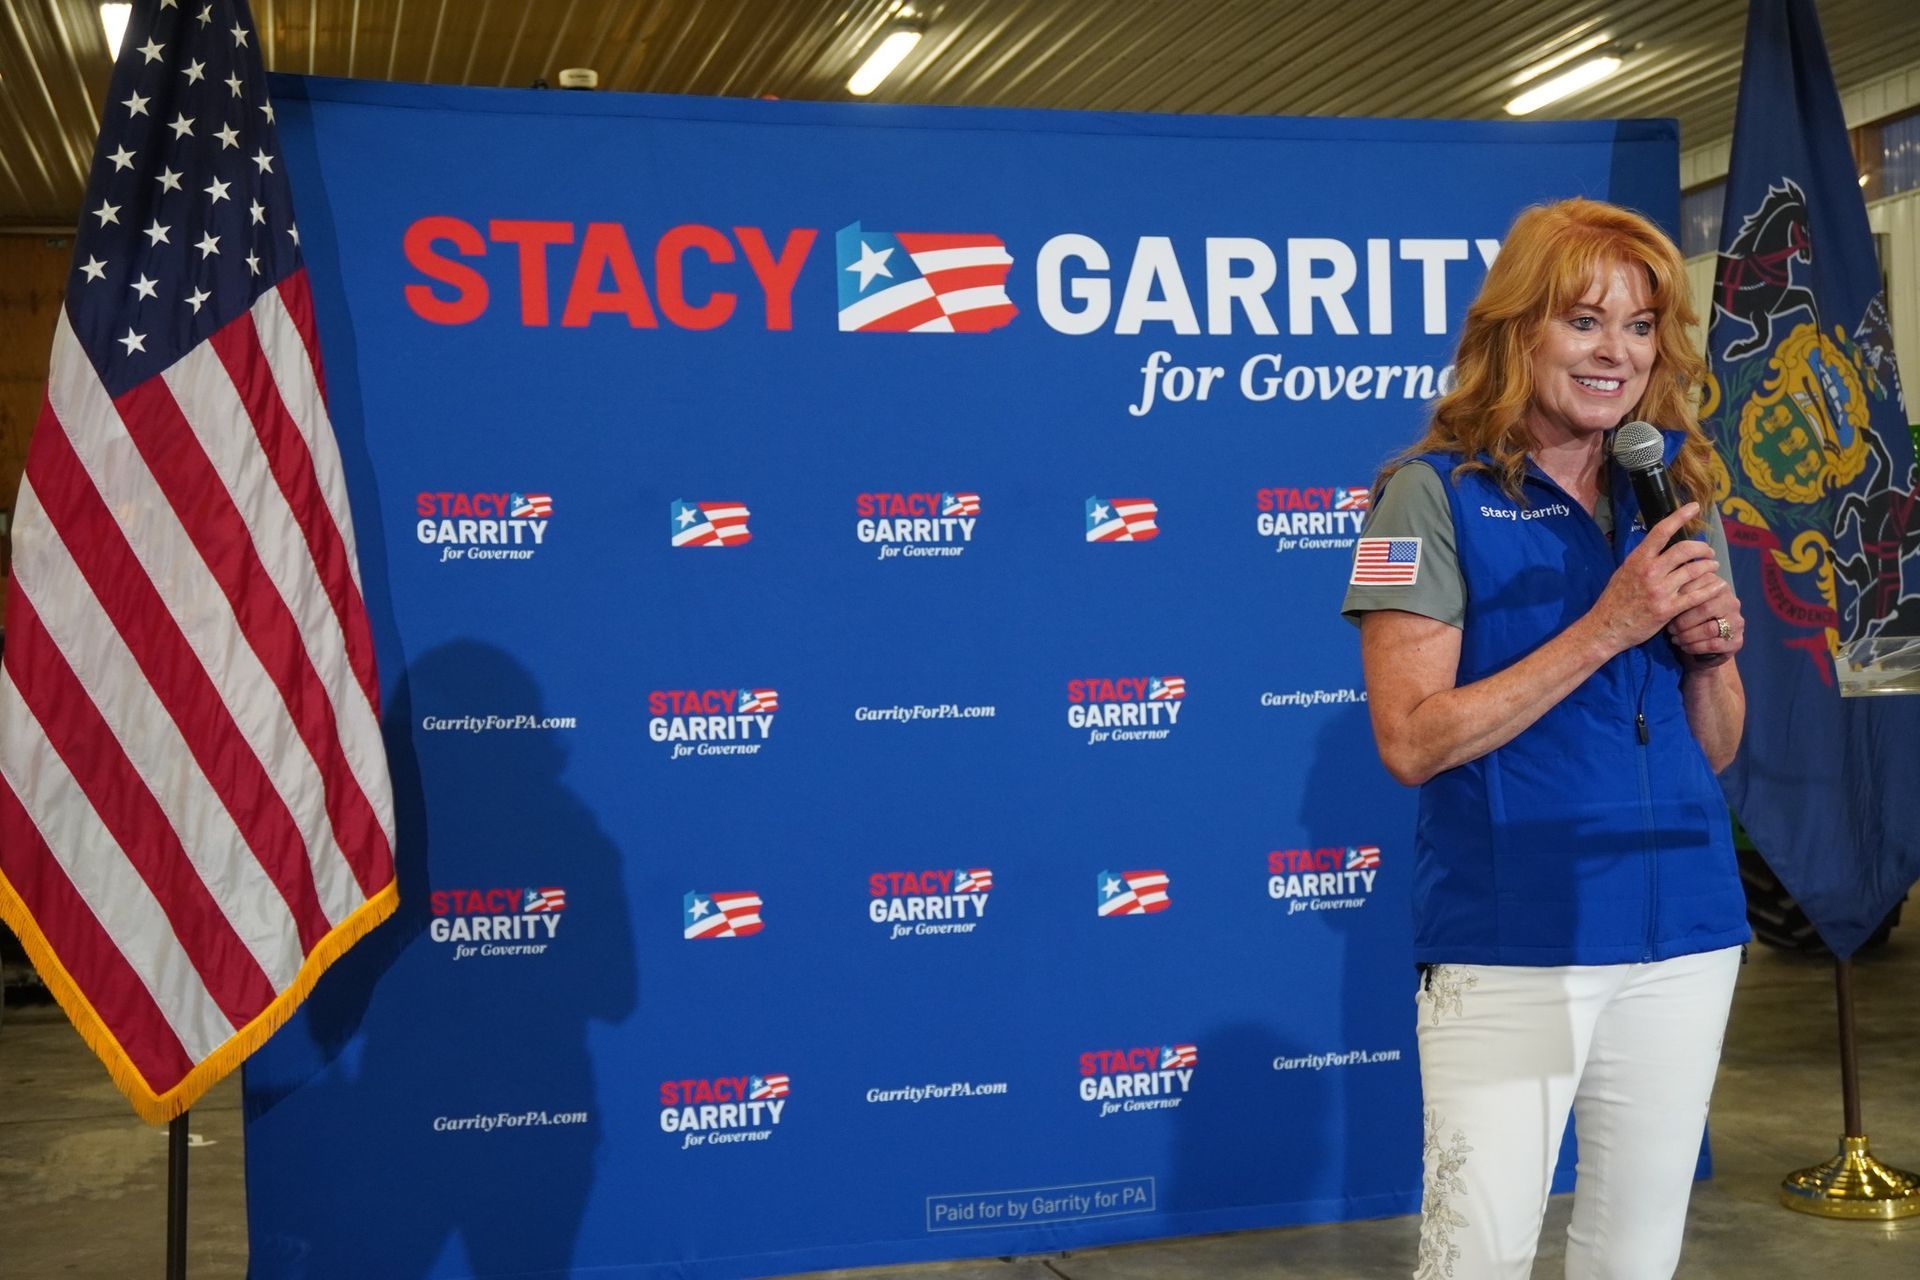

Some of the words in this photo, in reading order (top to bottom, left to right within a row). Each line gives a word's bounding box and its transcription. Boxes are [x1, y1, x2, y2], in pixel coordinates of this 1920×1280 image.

[403, 216, 818, 330] STACY
[1129, 351, 1224, 416] for
[1240, 354, 1456, 400] Govern
[417, 492, 508, 517] STACY
[857, 493, 942, 517] STACY
[1257, 488, 1334, 511] STACY
[1257, 511, 1365, 536] GARRITY
[1480, 506, 1517, 521] Stacy
[1521, 504, 1570, 521] Garrity
[417, 519, 547, 544] GARRITY
[857, 518, 976, 542] GARRITY
[440, 547, 463, 562] for
[468, 547, 534, 559] Governor
[878, 545, 899, 560] for
[903, 545, 963, 557] Governor
[1277, 537, 1297, 552] for
[1299, 537, 1355, 549] Governor
[1068, 677, 1148, 702] STACY
[1261, 689, 1368, 708] GarrityForPA.c
[649, 690, 737, 715] STACY
[855, 704, 996, 723] GarrityForPA.com
[1068, 701, 1182, 728] GARRITY
[423, 715, 576, 733] GarrityForPA.com
[649, 715, 774, 742] GARRITY
[1088, 730, 1109, 745] for
[1112, 729, 1169, 741] Governor
[671, 744, 694, 759] for
[697, 744, 760, 756] Governor
[1268, 848, 1344, 874] STACY
[870, 870, 953, 897] STACY
[1268, 870, 1376, 898] GARRITY
[431, 889, 522, 915] STACY
[870, 894, 988, 922] GARRITY
[1288, 900, 1308, 915] for
[1310, 898, 1365, 911] Governor
[431, 914, 561, 942] GARRITY
[890, 924, 912, 939] for
[913, 921, 976, 935] Governor
[453, 944, 478, 960] for
[481, 942, 547, 957] Governor
[1080, 1047, 1158, 1076] STACY
[1273, 1050, 1401, 1071] GarrityForPA.com
[661, 1077, 748, 1105] STACY
[867, 1082, 1008, 1103] GarrityForPA.com
[1080, 1069, 1193, 1101] GARRITY
[661, 1101, 785, 1131] GARRITY
[1100, 1101, 1121, 1117] for
[1123, 1096, 1181, 1112] Governor
[434, 1111, 588, 1131] GarrityForPA.com
[682, 1132, 705, 1149] for
[708, 1128, 771, 1145] Governor
[935, 1203, 974, 1221] Paid
[979, 1201, 1003, 1218] for
[1008, 1200, 1028, 1220] by
[1032, 1193, 1090, 1216] Garrity
[1094, 1191, 1119, 1208] for
[1123, 1187, 1147, 1205] PA
